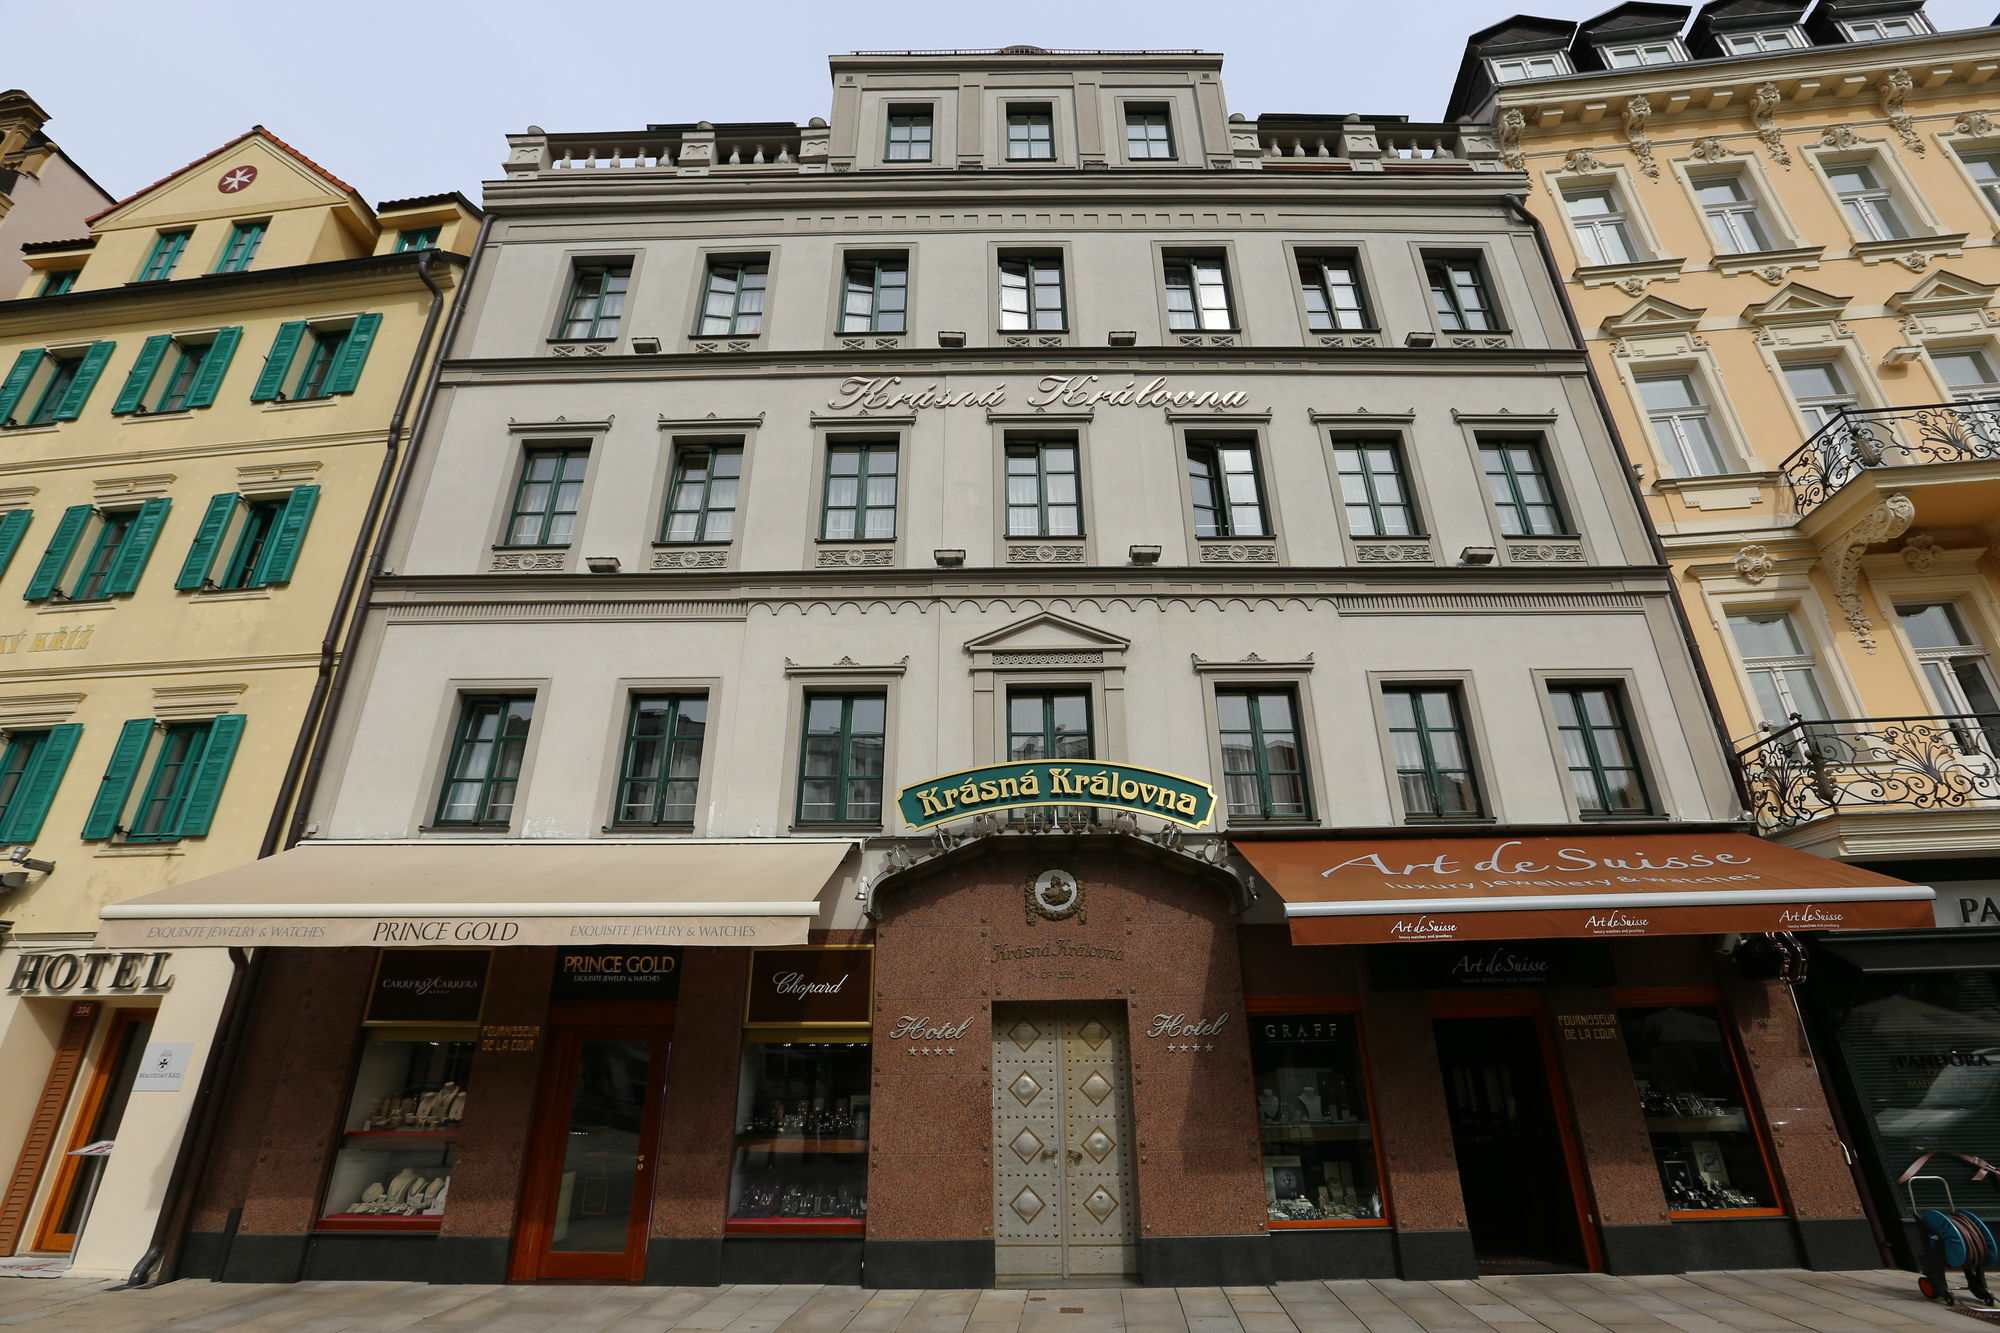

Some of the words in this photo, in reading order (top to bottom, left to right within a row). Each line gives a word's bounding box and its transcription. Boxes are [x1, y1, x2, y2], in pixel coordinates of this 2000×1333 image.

[827, 375, 1006, 410] Krásná
[1027, 374, 1249, 408] Královna
[27, 624, 96, 653] KŘÍŽ
[916, 769, 1041, 816] Krásná
[1048, 767, 1199, 816] Královna
[1321, 853, 1460, 878] Art
[1474, 840, 1550, 874] de
[1556, 848, 1752, 872] Suisse
[1384, 882, 1475, 890] luxury
[1480, 878, 1612, 888] jewellery
[1616, 875, 1639, 883] &
[1641, 872, 1761, 884] watches
[1584, 915, 1606, 929] Art
[1607, 910, 1620, 928] de
[1619, 914, 1649, 926] Suisse
[1779, 909, 1800, 923] Art
[1801, 904, 1816, 922] de
[1814, 909, 1844, 921] Suisse
[1959, 896, 2000, 924] PA
[147, 926, 206, 939] EXQUISITE
[205, 925, 258, 940] JEWELRY
[258, 926, 267, 938] &
[270, 925, 327, 938] WATCHES
[372, 921, 451, 942] PRINCE
[454, 921, 520, 941] GOLD
[569, 925, 632, 937] EXQUISITE
[631, 924, 684, 938] JEWELRY
[686, 925, 696, 937] &
[699, 924, 757, 937] WATCHES
[1390, 920, 1413, 934] Art
[1413, 915, 1427, 934] de
[1425, 919, 1458, 932] Suisse
[562, 955, 624, 974] PRINCE
[626, 954, 676, 974] GOLD
[1451, 954, 1485, 976] Art
[1485, 946, 1505, 975] de
[1503, 954, 1549, 973] Suisse
[5, 952, 176, 993] HOTEL
[573, 975, 603, 983] EXQUISITE
[602, 975, 627, 983] JEWELRY
[627, 975, 633, 983] &
[633, 974, 661, 983] WATCHES
[772, 971, 849, 1001] Chopard
[889, 1015, 975, 1040] Hotel
[1146, 1012, 1230, 1038] Hotel
[1557, 1013, 1617, 1027] FOURNISSEUR
[481, 1025, 542, 1038] FOURNISSEUR
[1264, 1023, 1337, 1038] GRAFF
[1563, 1028, 1577, 1041] DE
[1578, 1028, 1592, 1040] LA
[1593, 1027, 1617, 1040] COUR
[481, 1039, 495, 1051] DE
[495, 1039, 509, 1051] LA
[511, 1039, 536, 1051] COUR
